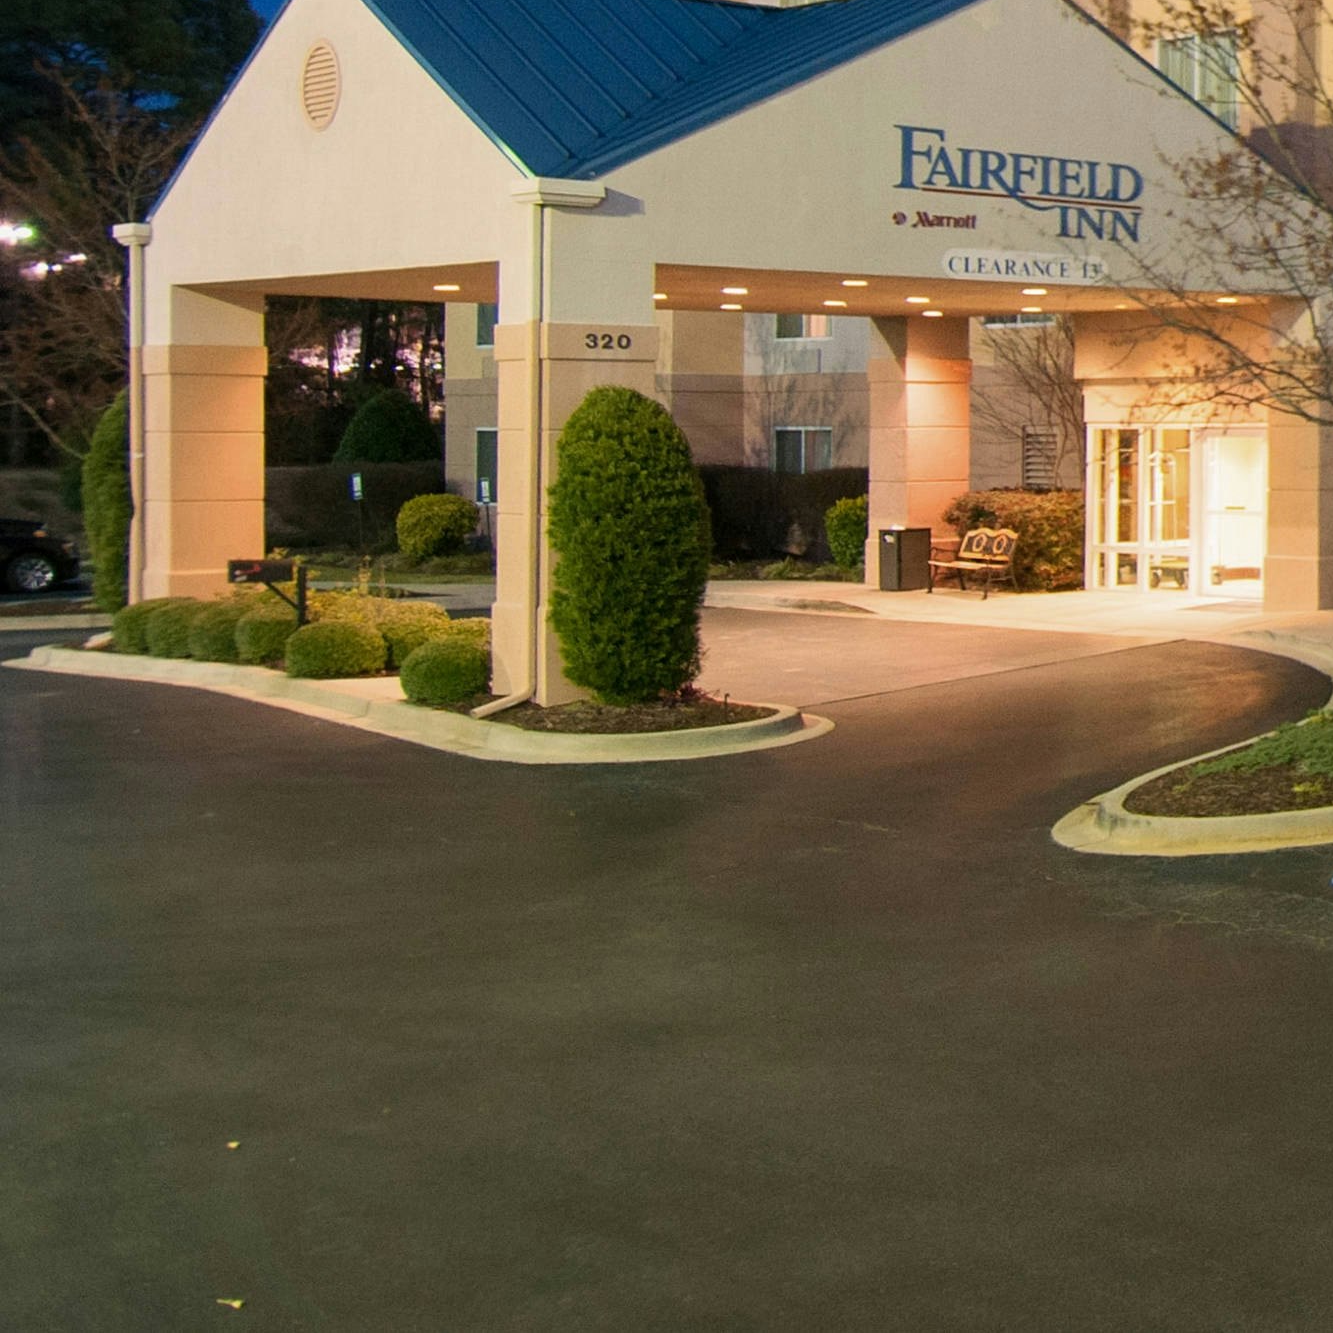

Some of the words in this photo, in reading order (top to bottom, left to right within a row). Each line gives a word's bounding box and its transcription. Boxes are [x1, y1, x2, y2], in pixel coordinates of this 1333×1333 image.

[893, 124, 1144, 207] FAIRFIELD
[911, 211, 977, 229] Marriott
[1054, 205, 1143, 243] INN
[948, 257, 1070, 278] CLEARANCE
[585, 333, 632, 350] 320
